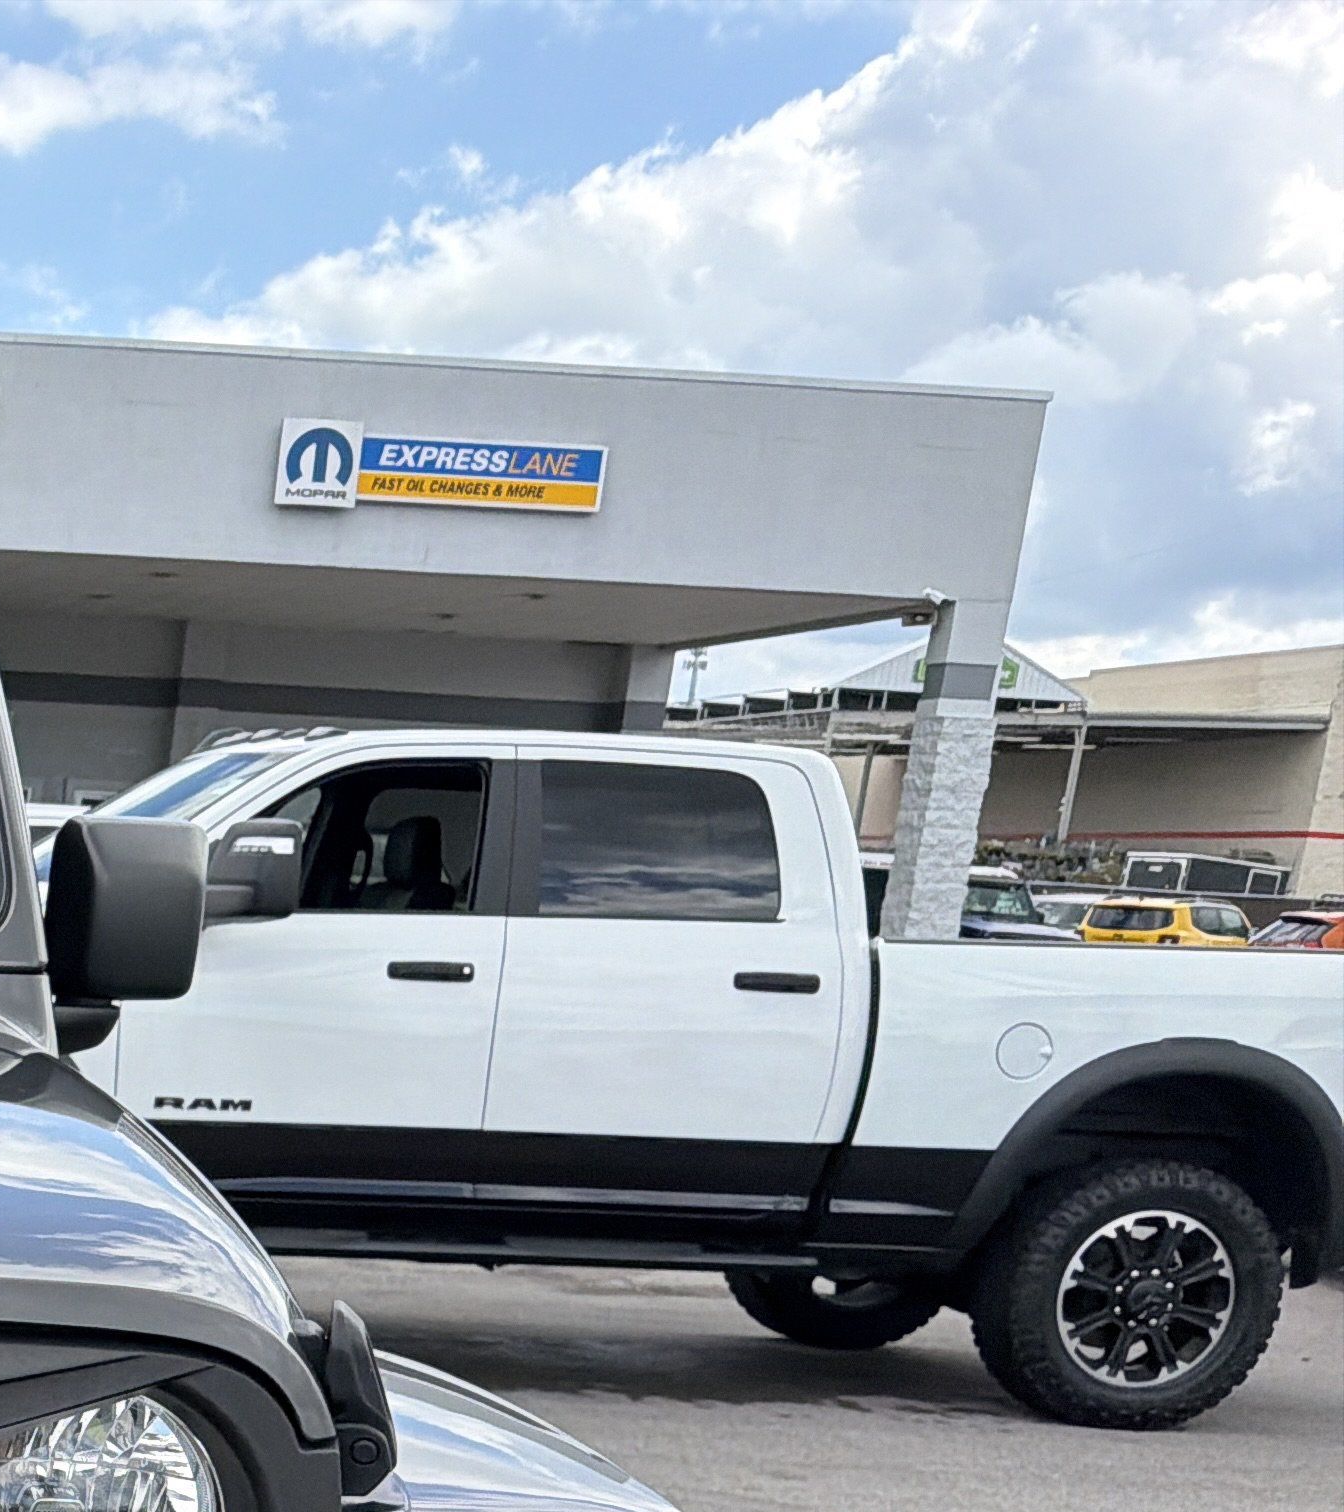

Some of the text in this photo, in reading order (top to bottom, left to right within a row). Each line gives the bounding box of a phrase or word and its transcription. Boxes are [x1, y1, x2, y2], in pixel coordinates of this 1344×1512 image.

[284, 487, 347, 500] MOPAR
[371, 477, 545, 499] FAST OIL CHANGES & MORE
[154, 1096, 253, 1112] RAM
